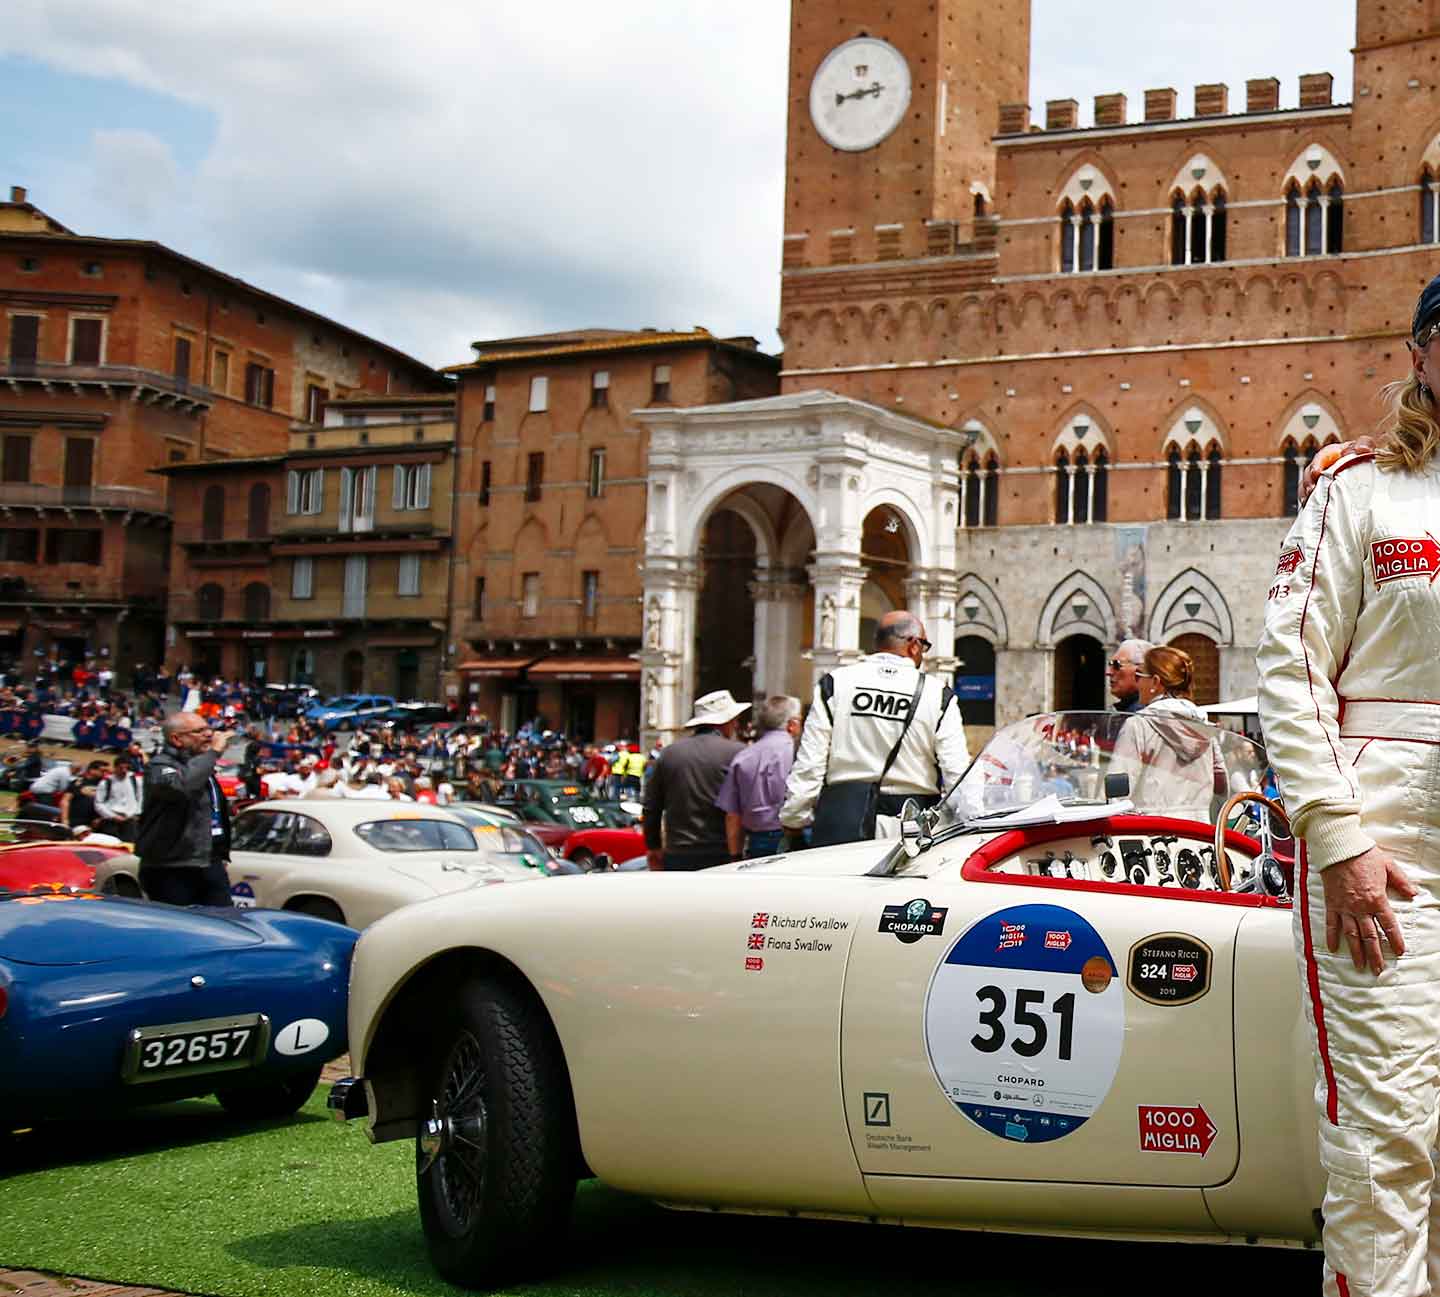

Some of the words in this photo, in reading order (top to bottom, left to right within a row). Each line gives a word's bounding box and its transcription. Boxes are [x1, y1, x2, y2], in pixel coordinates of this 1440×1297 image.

[1376, 541, 1423, 558] 1000
[1376, 557, 1430, 577] MIGLIA
[852, 692, 911, 716] OMP
[770, 915, 807, 929] Richard
[809, 916, 850, 931] Swallow
[887, 922, 934, 933] CHOPARD
[1000, 932, 1025, 940] MIGLIA
[767, 937, 792, 951] Fiona
[794, 937, 833, 952] Swallow
[1142, 948, 1176, 958] STEFANO
[1178, 949, 1200, 959] RICCI
[1140, 963, 1168, 979] 324
[970, 985, 1075, 1061] 351
[294, 1025, 310, 1050] L
[143, 1030, 250, 1068] 32657
[997, 1074, 1045, 1087] CHOPARD
[1145, 1111, 1196, 1127] 1000
[1144, 1132, 1200, 1149] MIGLIA
